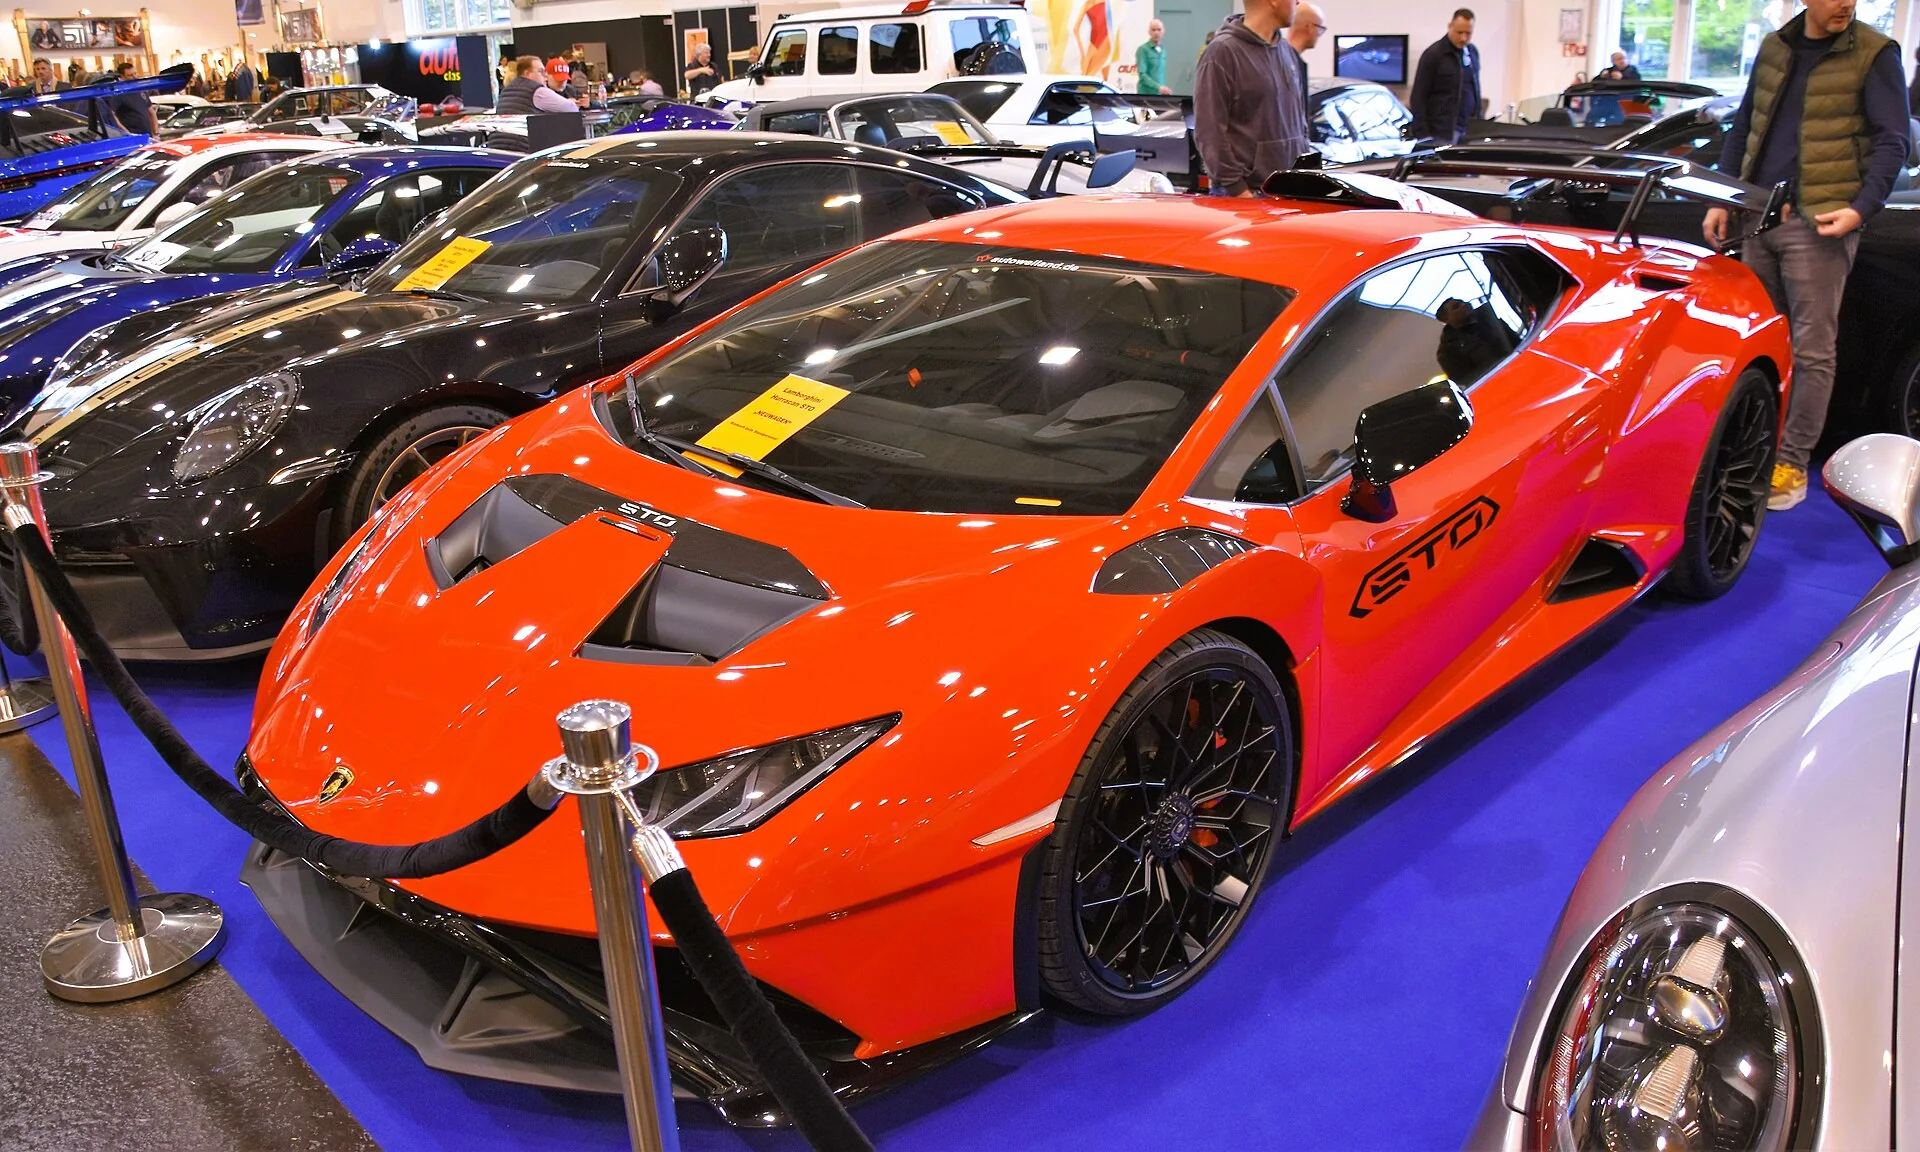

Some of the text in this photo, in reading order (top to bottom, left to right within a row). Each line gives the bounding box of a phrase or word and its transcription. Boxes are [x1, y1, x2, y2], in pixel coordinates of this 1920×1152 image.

[135, 250, 173, 267] SOD
[783, 388, 824, 403] Lamborghini
[800, 403, 815, 412] STO
[617, 502, 677, 527] STO
[1370, 509, 1483, 605] STO
